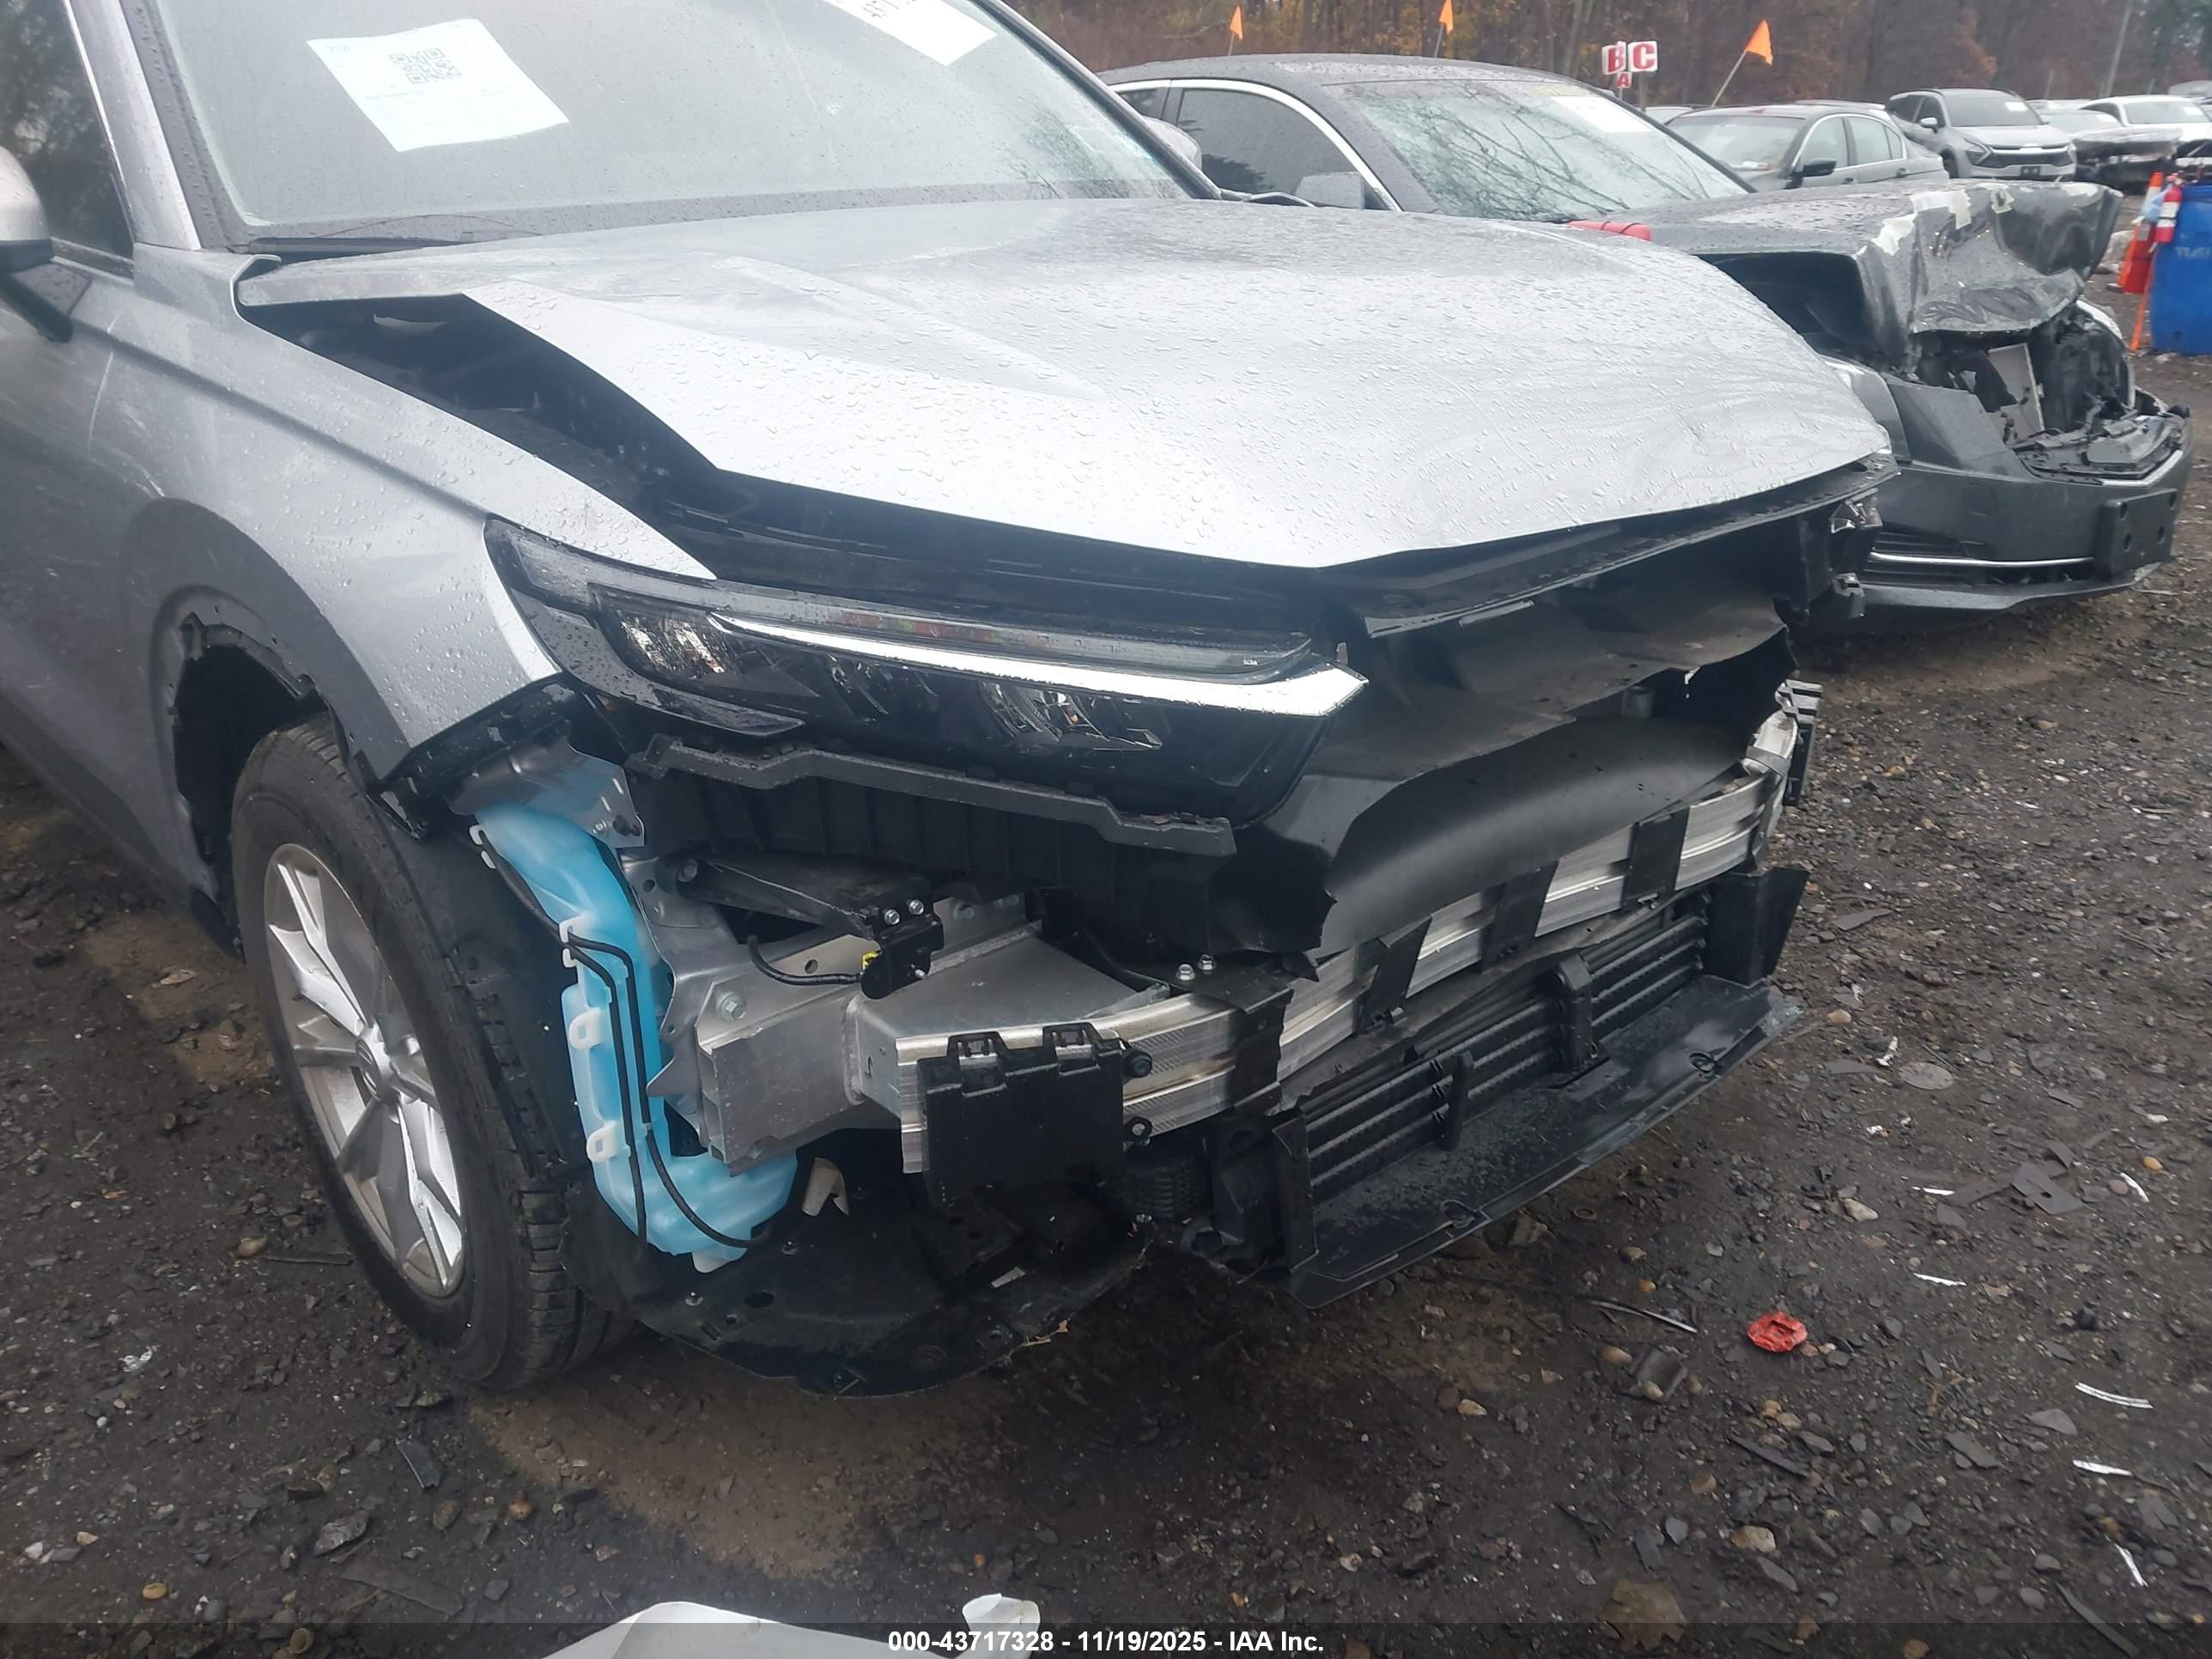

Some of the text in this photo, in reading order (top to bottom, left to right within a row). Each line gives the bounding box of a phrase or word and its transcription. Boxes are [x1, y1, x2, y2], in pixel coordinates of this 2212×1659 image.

[1607, 45, 1625, 73] B
[1632, 43, 1656, 70] C
[1616, 73, 1630, 88] A
